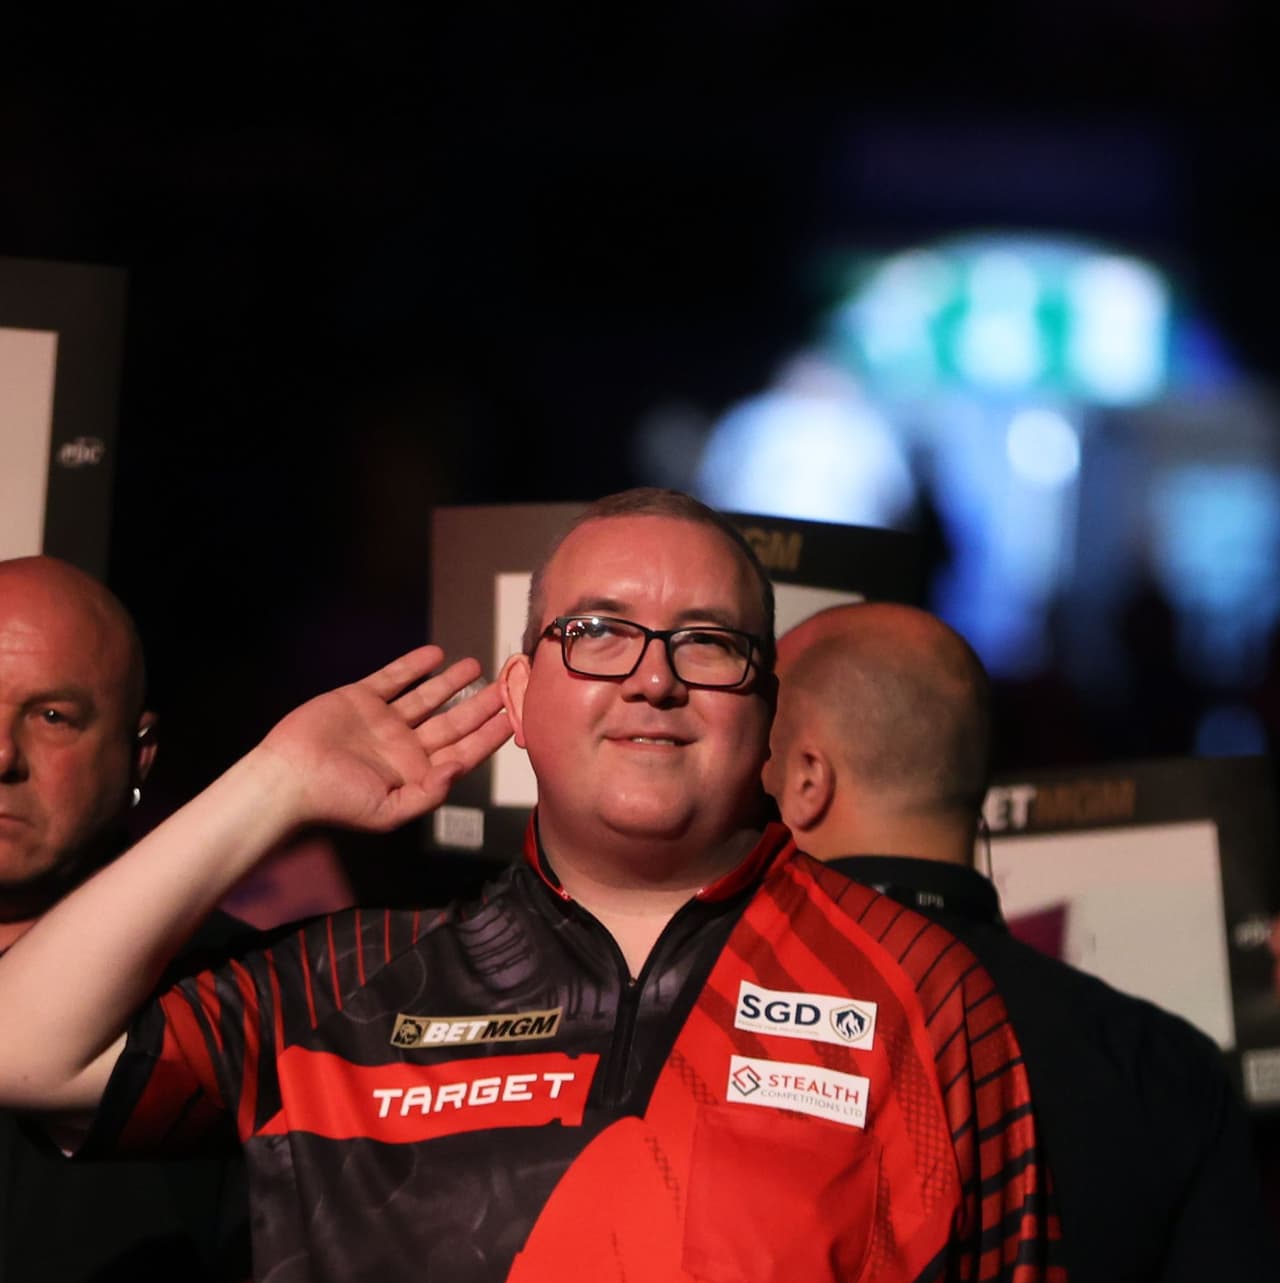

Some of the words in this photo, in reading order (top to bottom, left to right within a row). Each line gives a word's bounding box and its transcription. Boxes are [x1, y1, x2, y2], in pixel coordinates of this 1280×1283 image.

[740, 994, 821, 1026] SGD
[423, 1014, 560, 1043] BETMGM
[373, 1072, 575, 1118] TARGET
[760, 1089, 841, 1113] COMPETITIONS
[843, 1107, 864, 1118] LTD
[769, 1074, 860, 1105] STEALTH
